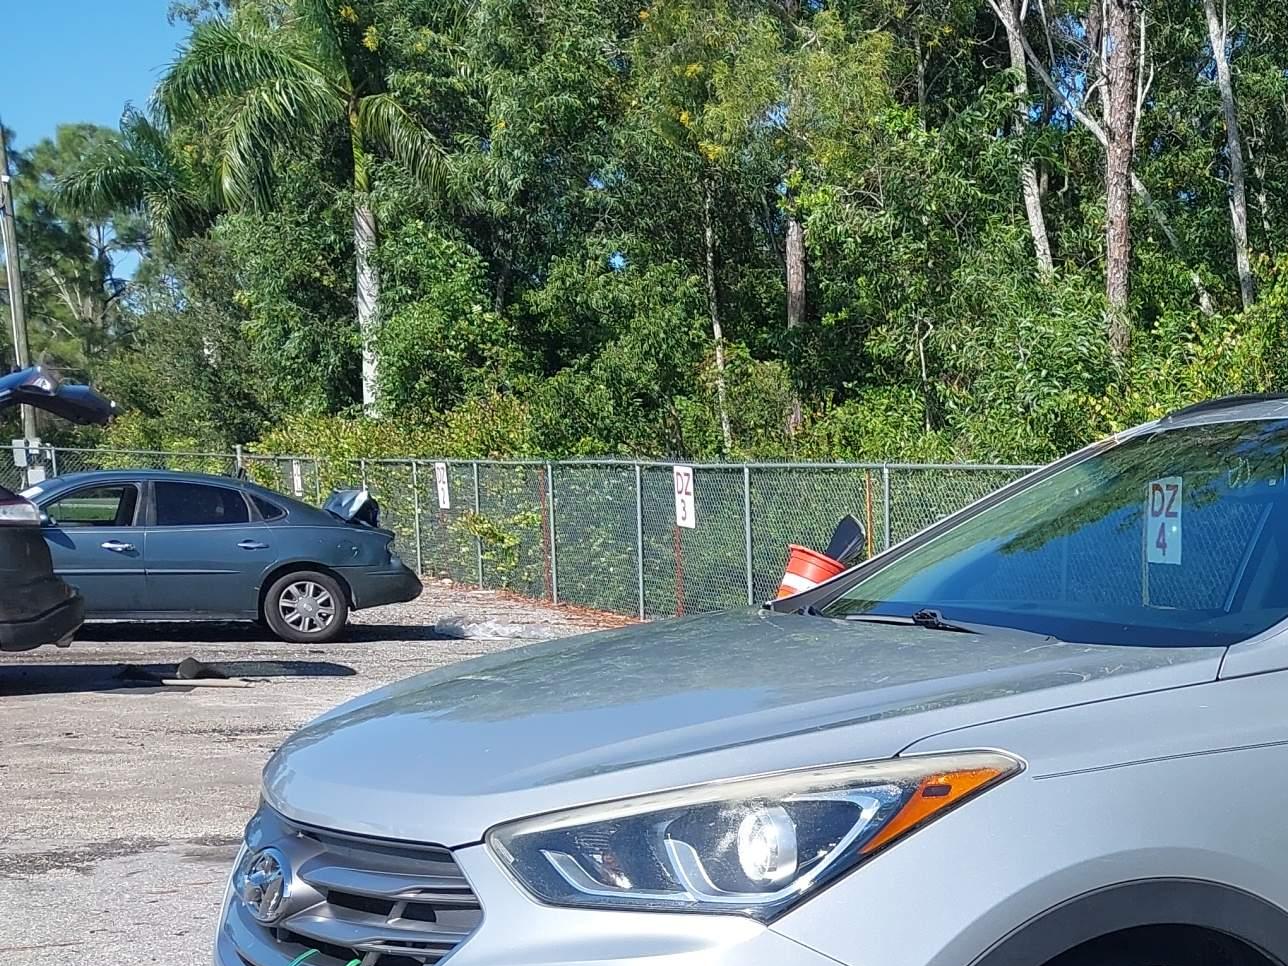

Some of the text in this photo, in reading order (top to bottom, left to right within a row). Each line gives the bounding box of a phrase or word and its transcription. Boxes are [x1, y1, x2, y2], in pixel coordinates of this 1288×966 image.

[675, 472, 692, 496] DZ
[680, 499, 687, 521] 3
[1151, 483, 1179, 518] DZ
[1155, 521, 1168, 557] 4
